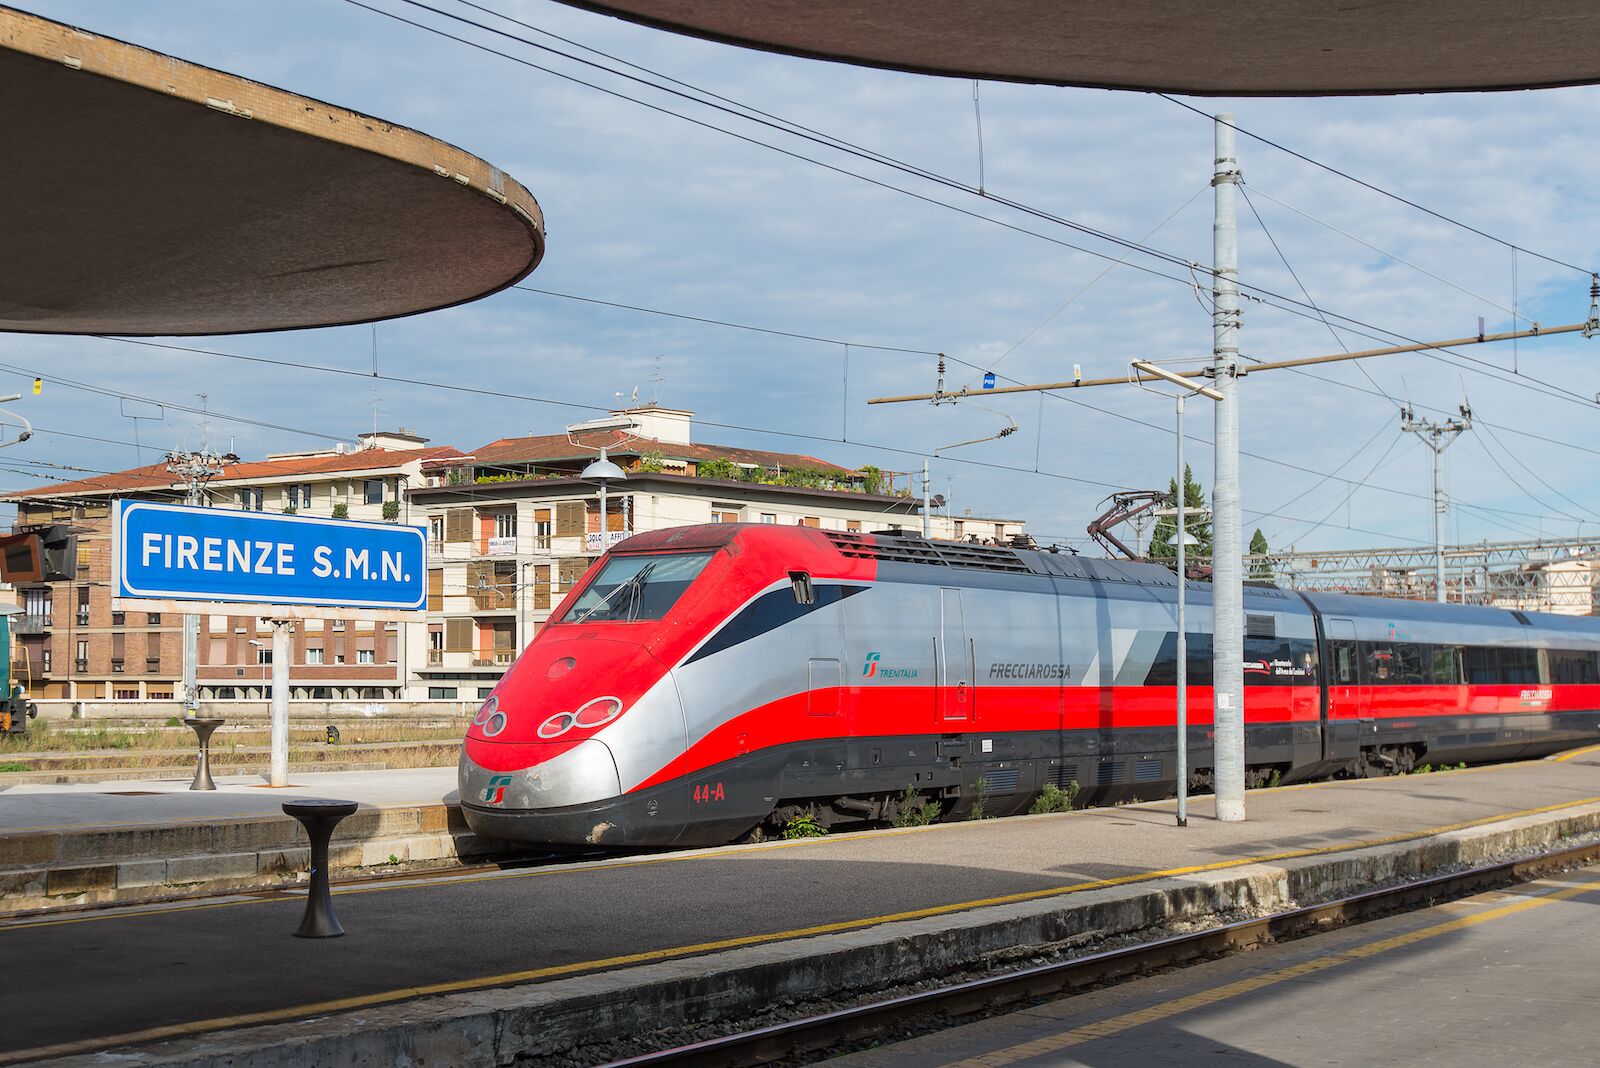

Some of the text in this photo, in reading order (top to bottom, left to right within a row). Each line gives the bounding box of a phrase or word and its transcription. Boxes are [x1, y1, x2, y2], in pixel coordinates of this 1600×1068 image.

[142, 532, 411, 583] FIRENZE S.M.N.
[880, 669, 918, 679] TRENITALIA
[989, 663, 1071, 679] FRECCIAROSSA
[693, 782, 725, 803] 44-A
